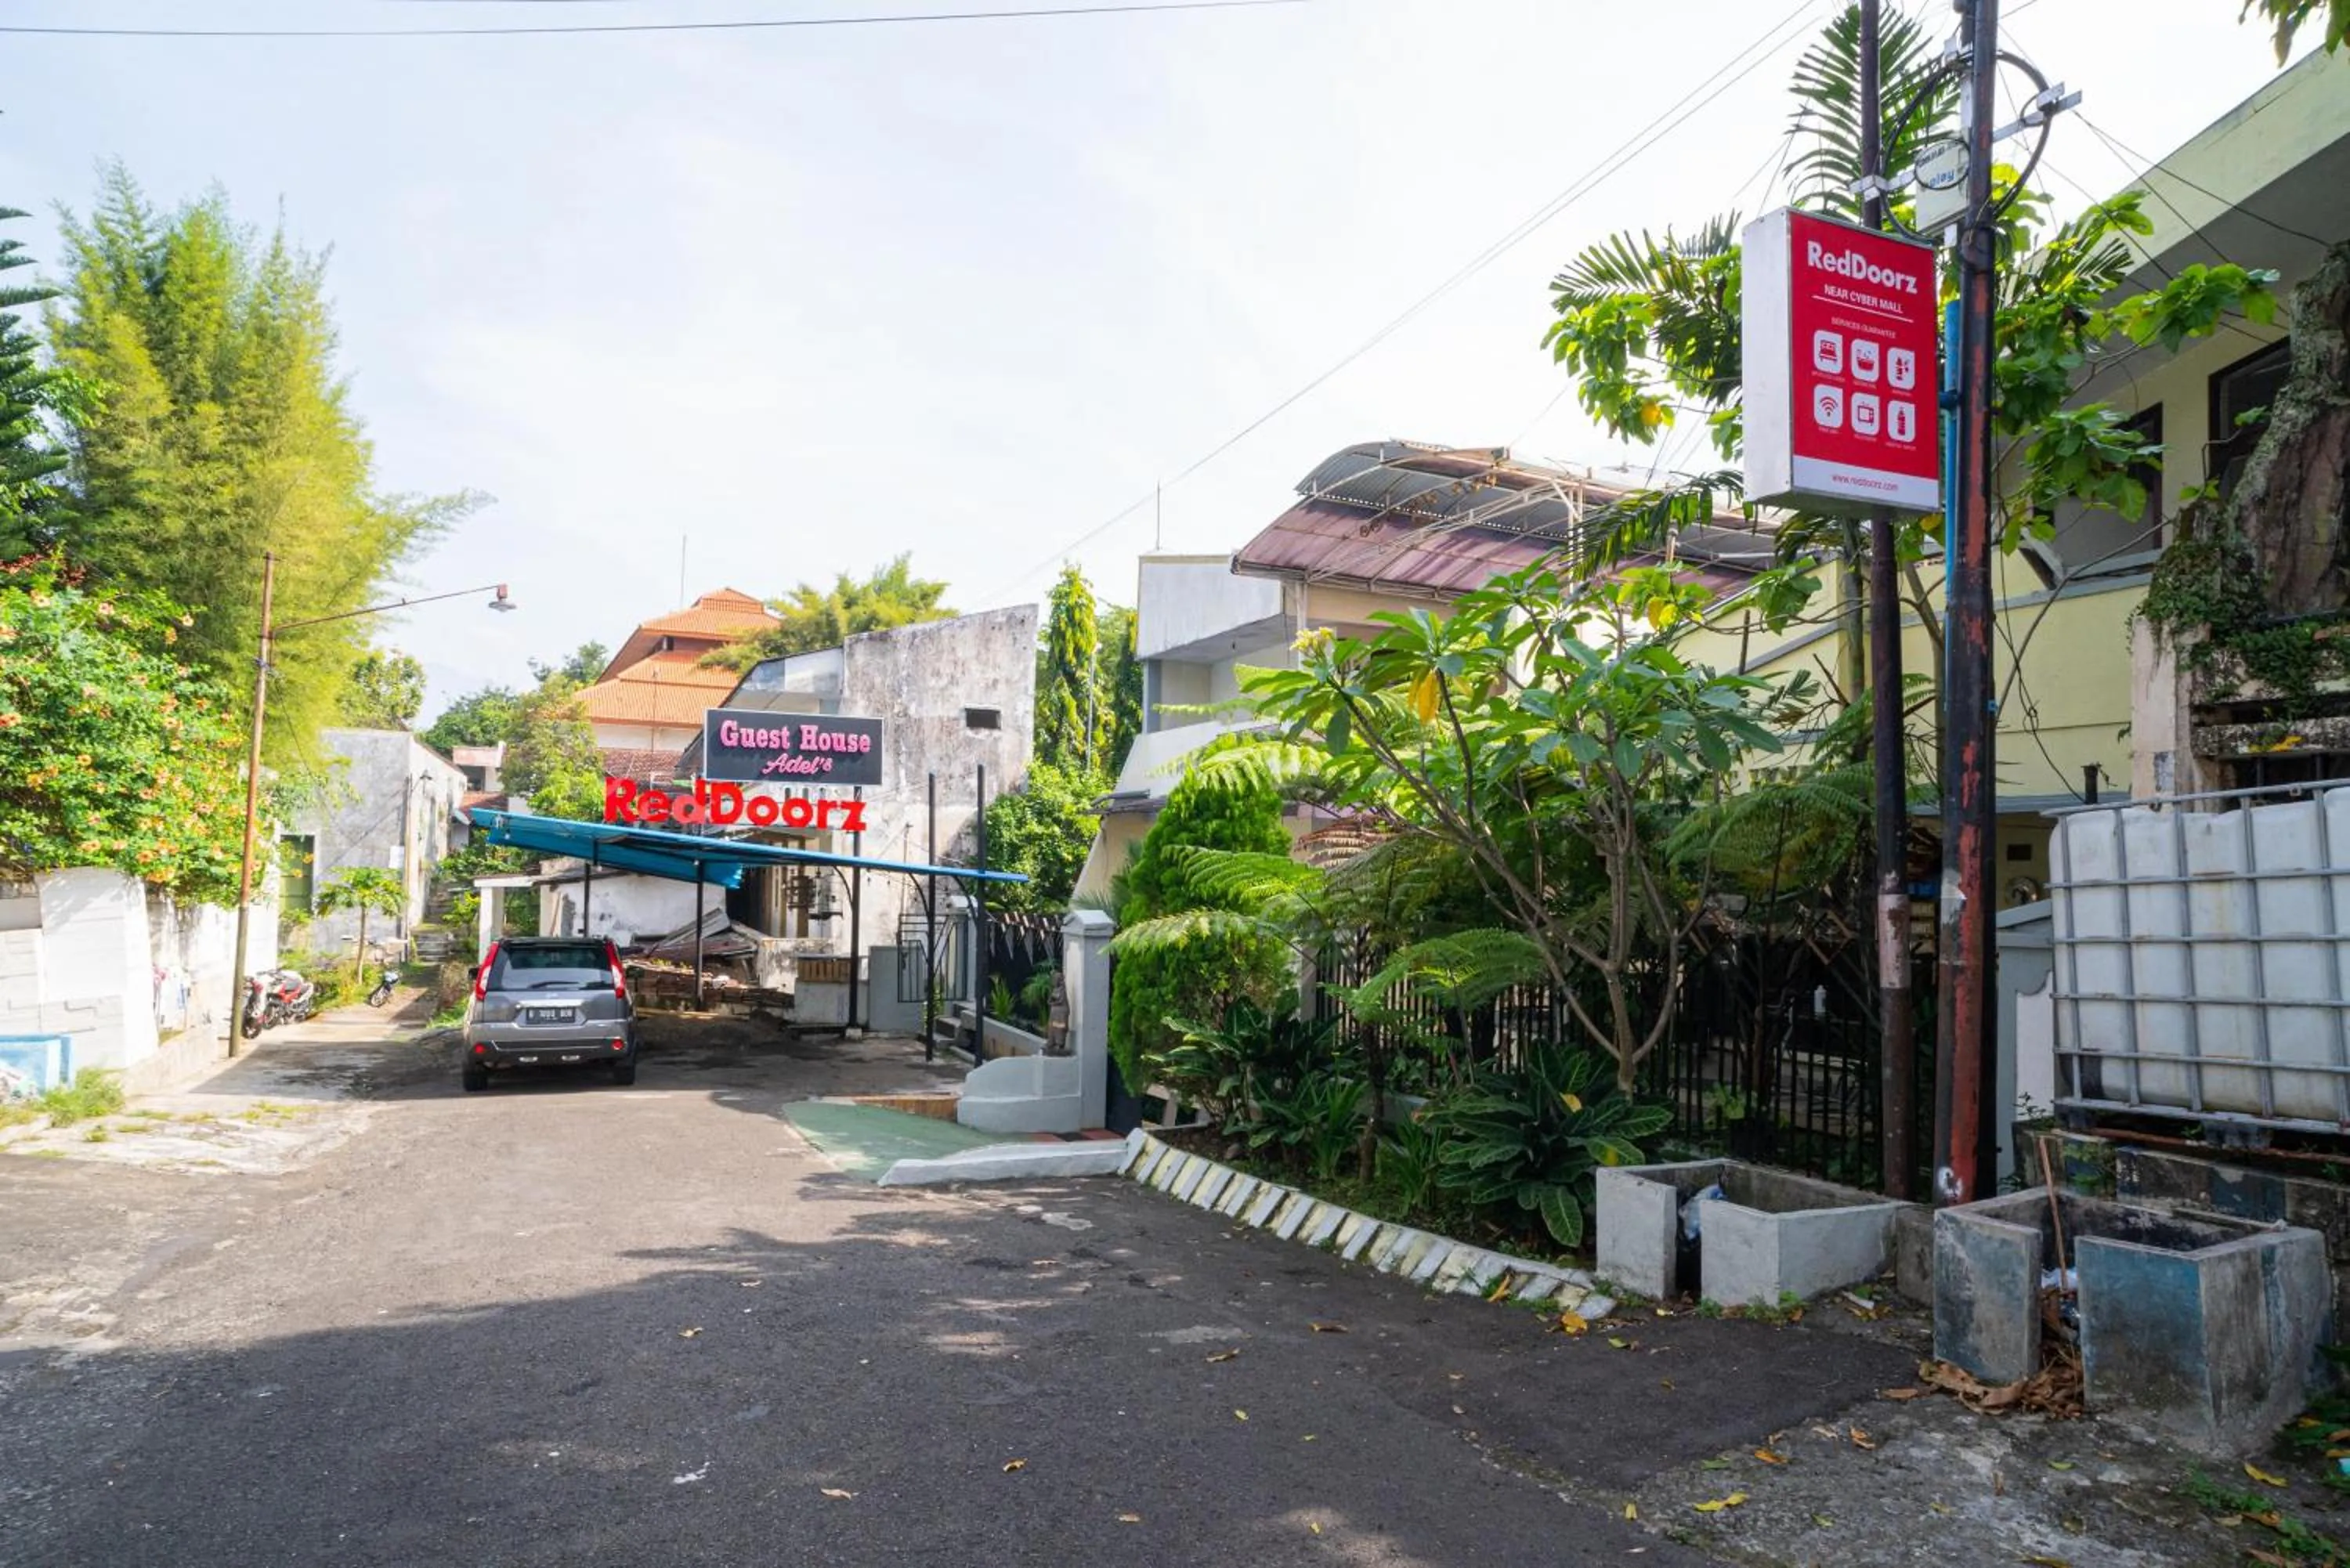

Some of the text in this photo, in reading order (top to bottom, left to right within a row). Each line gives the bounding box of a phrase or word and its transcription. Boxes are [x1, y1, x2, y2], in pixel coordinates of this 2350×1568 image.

[1807, 240, 1918, 294] RedDoorz
[1824, 283, 1904, 314] NEAR CYBER MALL
[720, 720, 871, 753] Guest House
[761, 753, 833, 775] Adel's
[604, 776, 867, 832] RedDoorz
